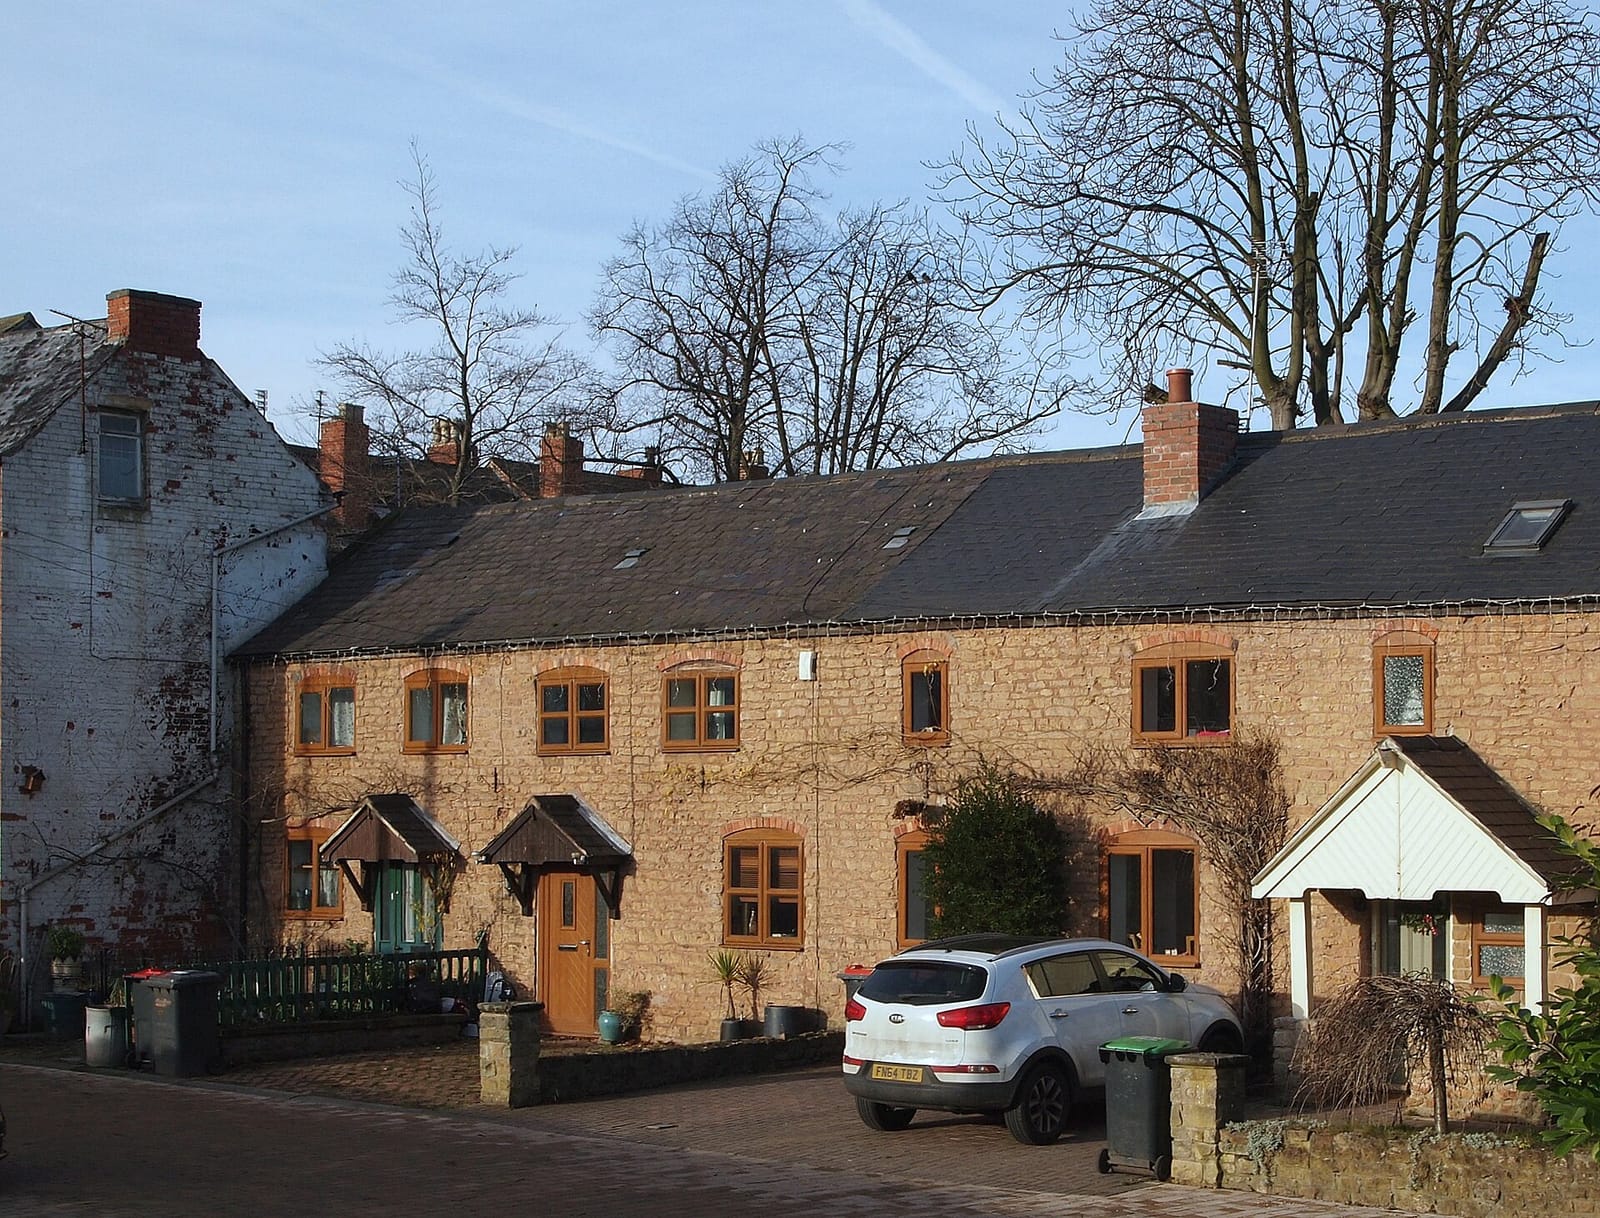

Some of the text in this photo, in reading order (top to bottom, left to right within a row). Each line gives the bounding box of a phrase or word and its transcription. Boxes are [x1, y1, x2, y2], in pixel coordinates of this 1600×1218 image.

[890, 1014, 904, 1022] KIA
[876, 1066, 919, 1080] FN64 TBZ
